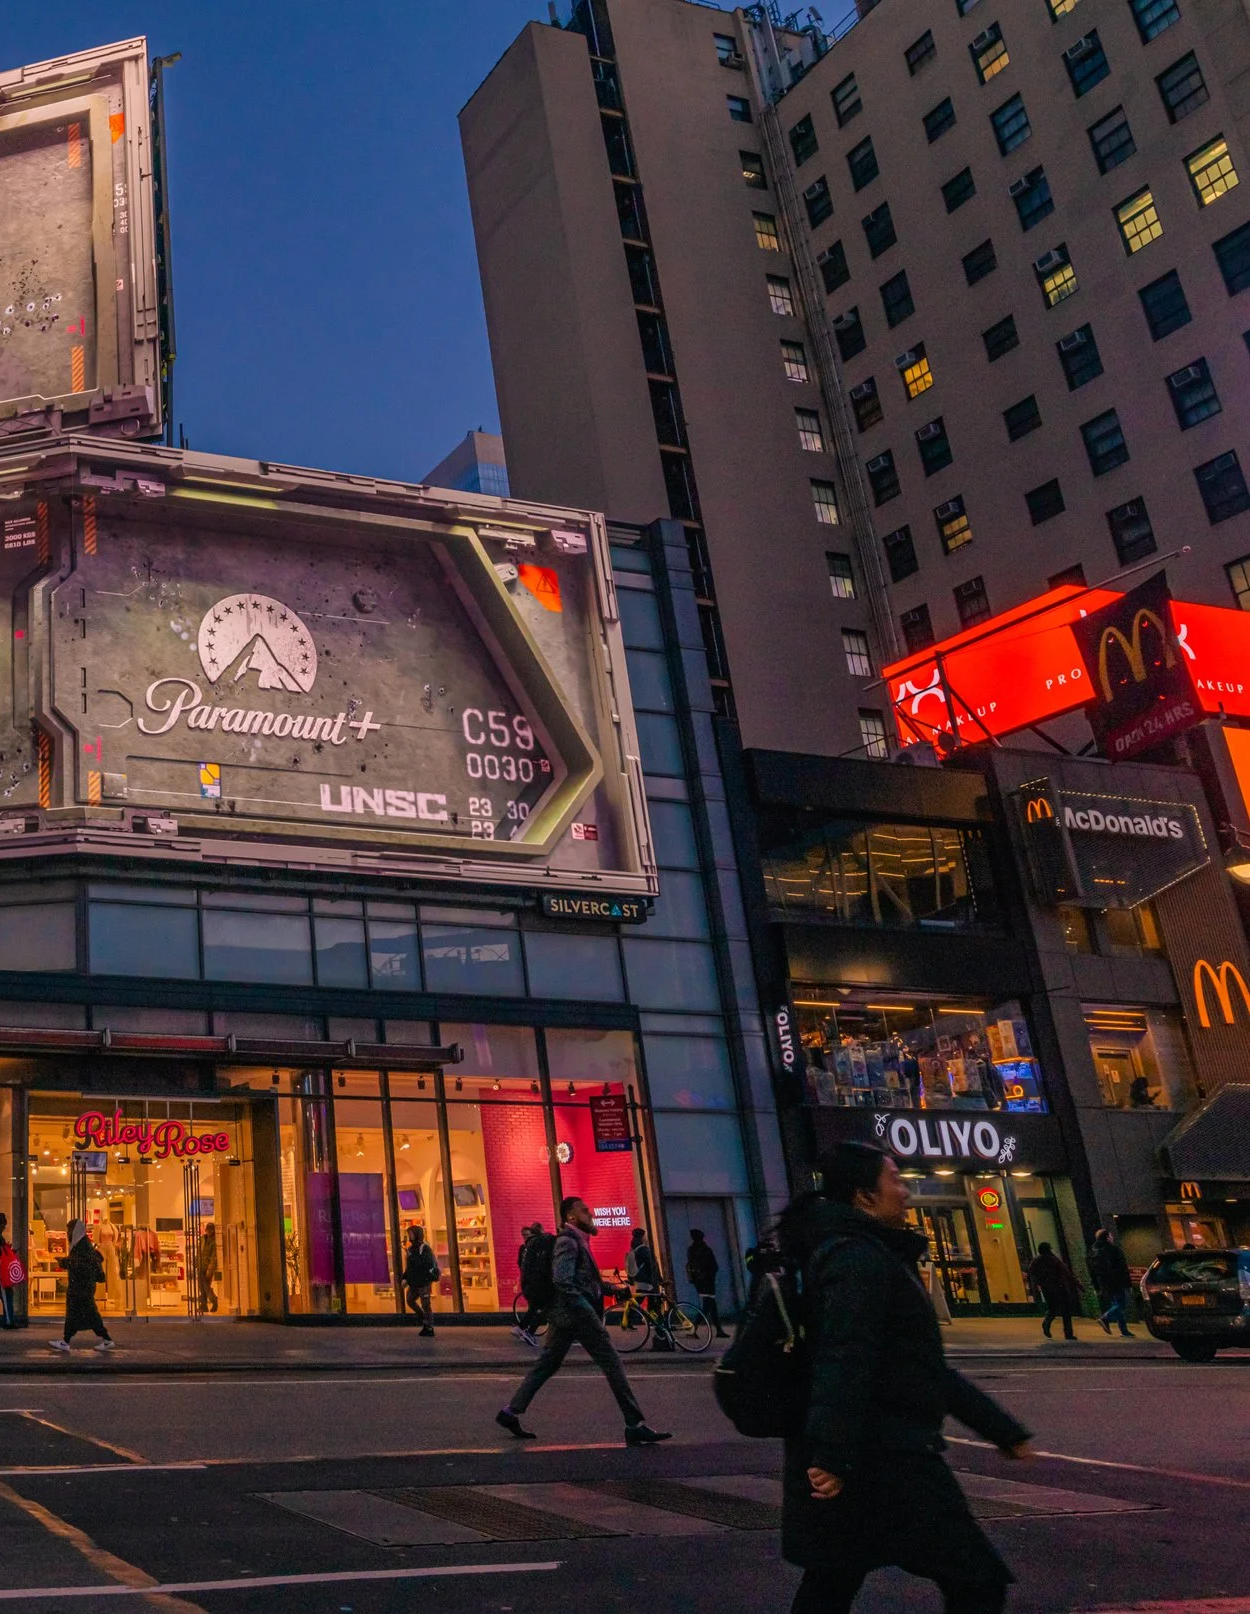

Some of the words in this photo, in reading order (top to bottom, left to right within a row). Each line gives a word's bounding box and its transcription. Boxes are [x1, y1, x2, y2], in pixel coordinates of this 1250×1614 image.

[1143, 717, 1164, 736] 24
[1164, 701, 1195, 725] HRS
[466, 753, 535, 783] 0030
[320, 783, 448, 821] UNSC
[469, 797, 493, 817] 23
[506, 801, 529, 820] 30
[776, 1011, 795, 1064] OLIYO
[74, 1108, 154, 1154] Riley
[154, 1120, 230, 1158] Rose
[890, 1118, 1000, 1158] OLIYO
[592, 1217, 612, 1227] WERE
[612, 1216, 631, 1226] HERE
[593, 1207, 612, 1217] WISH
[612, 1206, 627, 1216] YOU
